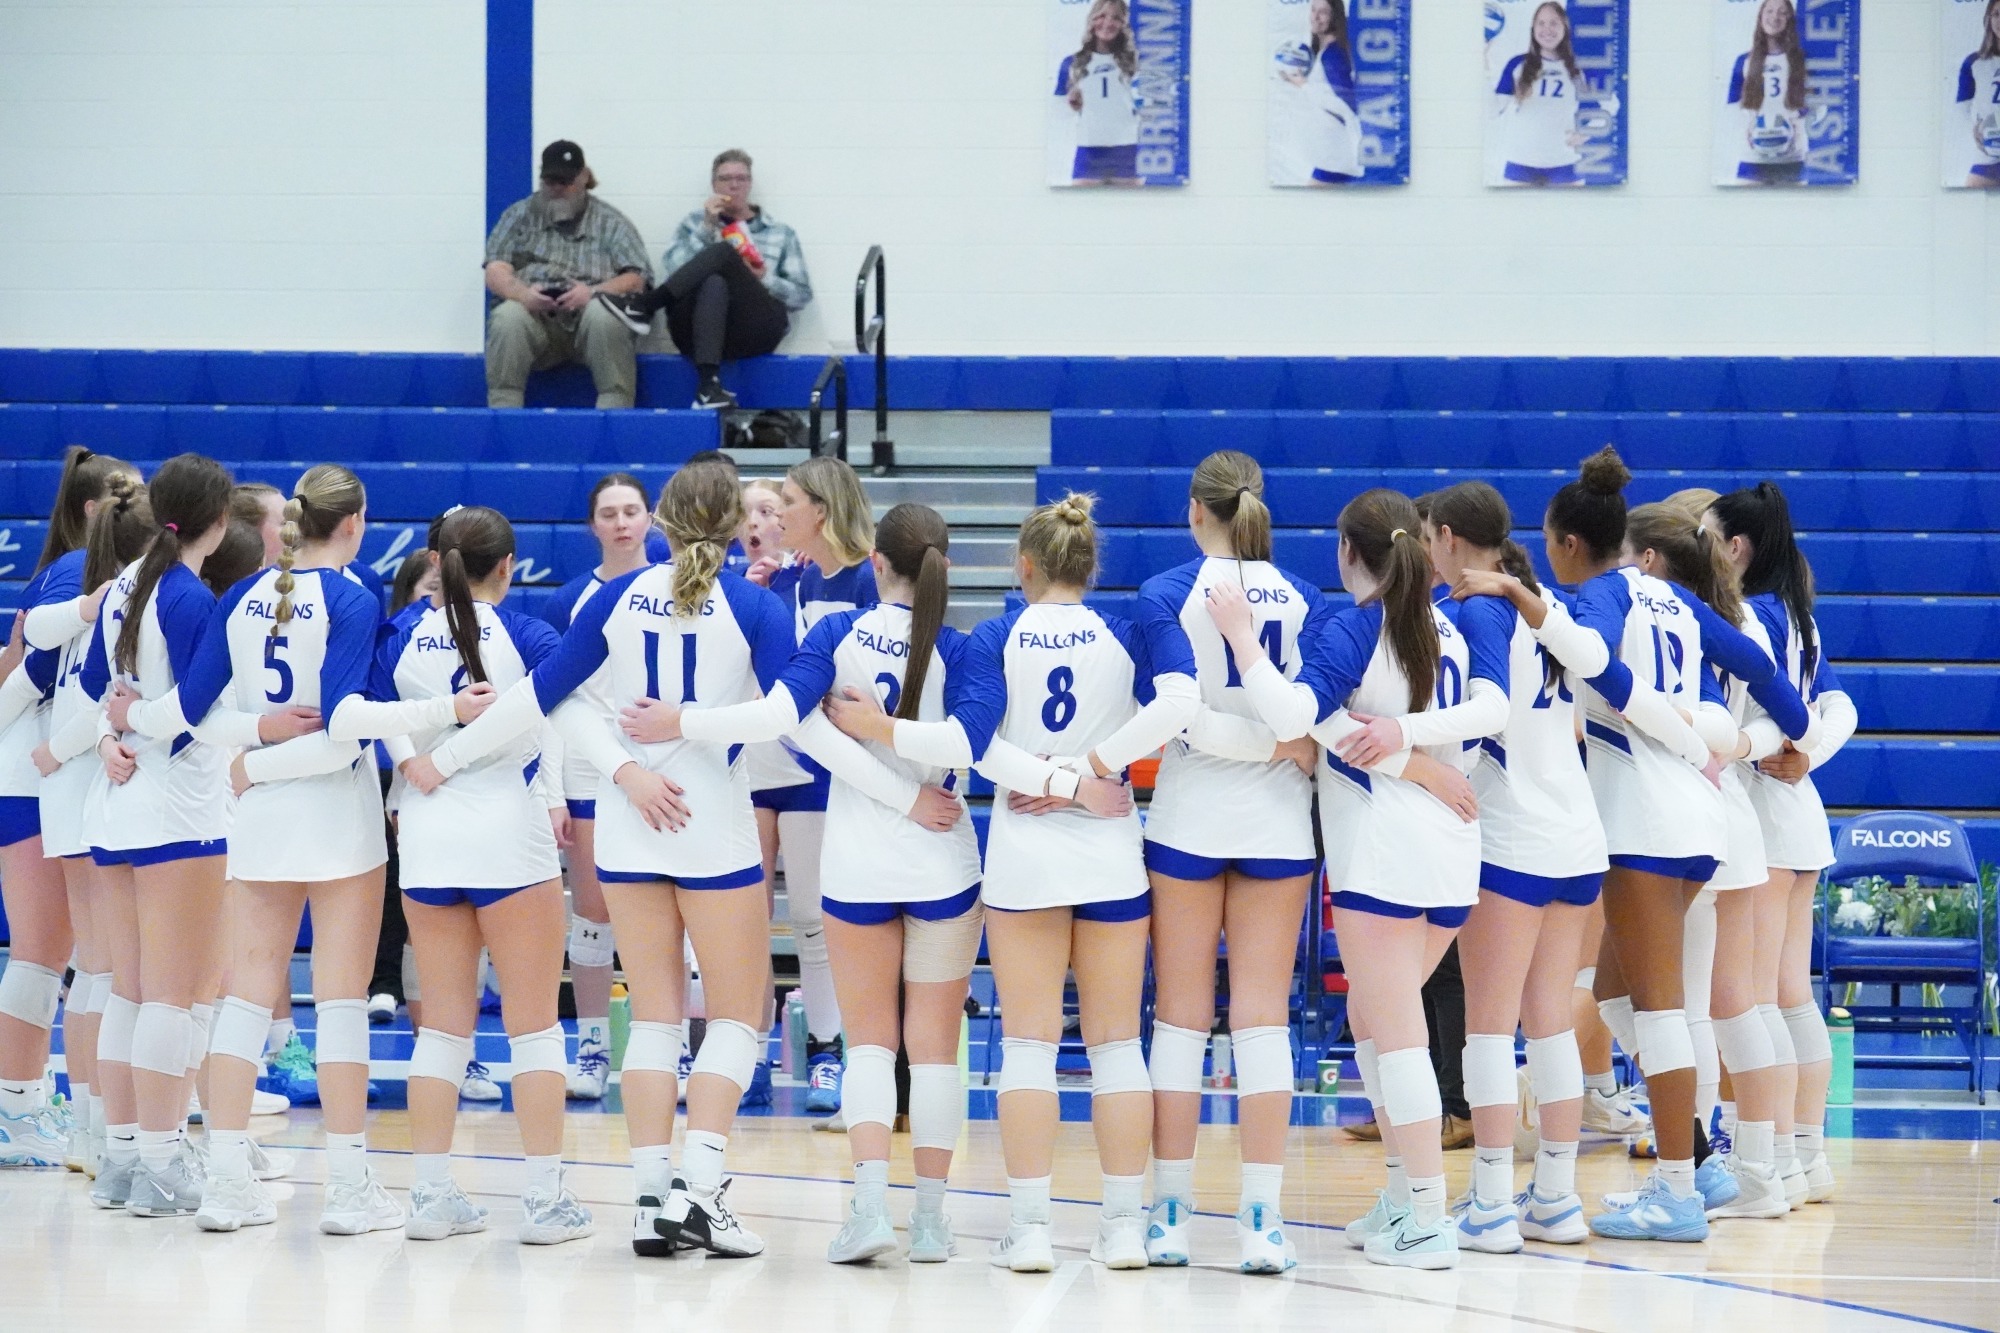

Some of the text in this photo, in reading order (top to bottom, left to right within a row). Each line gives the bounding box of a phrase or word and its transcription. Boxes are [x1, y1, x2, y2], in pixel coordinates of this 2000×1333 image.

[1540, 79, 1563, 97] 12
[1573, 0, 1614, 175] NOELL
[1769, 77, 1780, 97] 3
[246, 600, 313, 619] FALNS
[1019, 630, 1096, 649] FALCONS
[264, 635, 294, 703] 5
[641, 630, 698, 704] 11
[1041, 665, 1077, 732] 8
[1851, 829, 1952, 848] FALCONS
[1323, 1068, 1338, 1085] G
